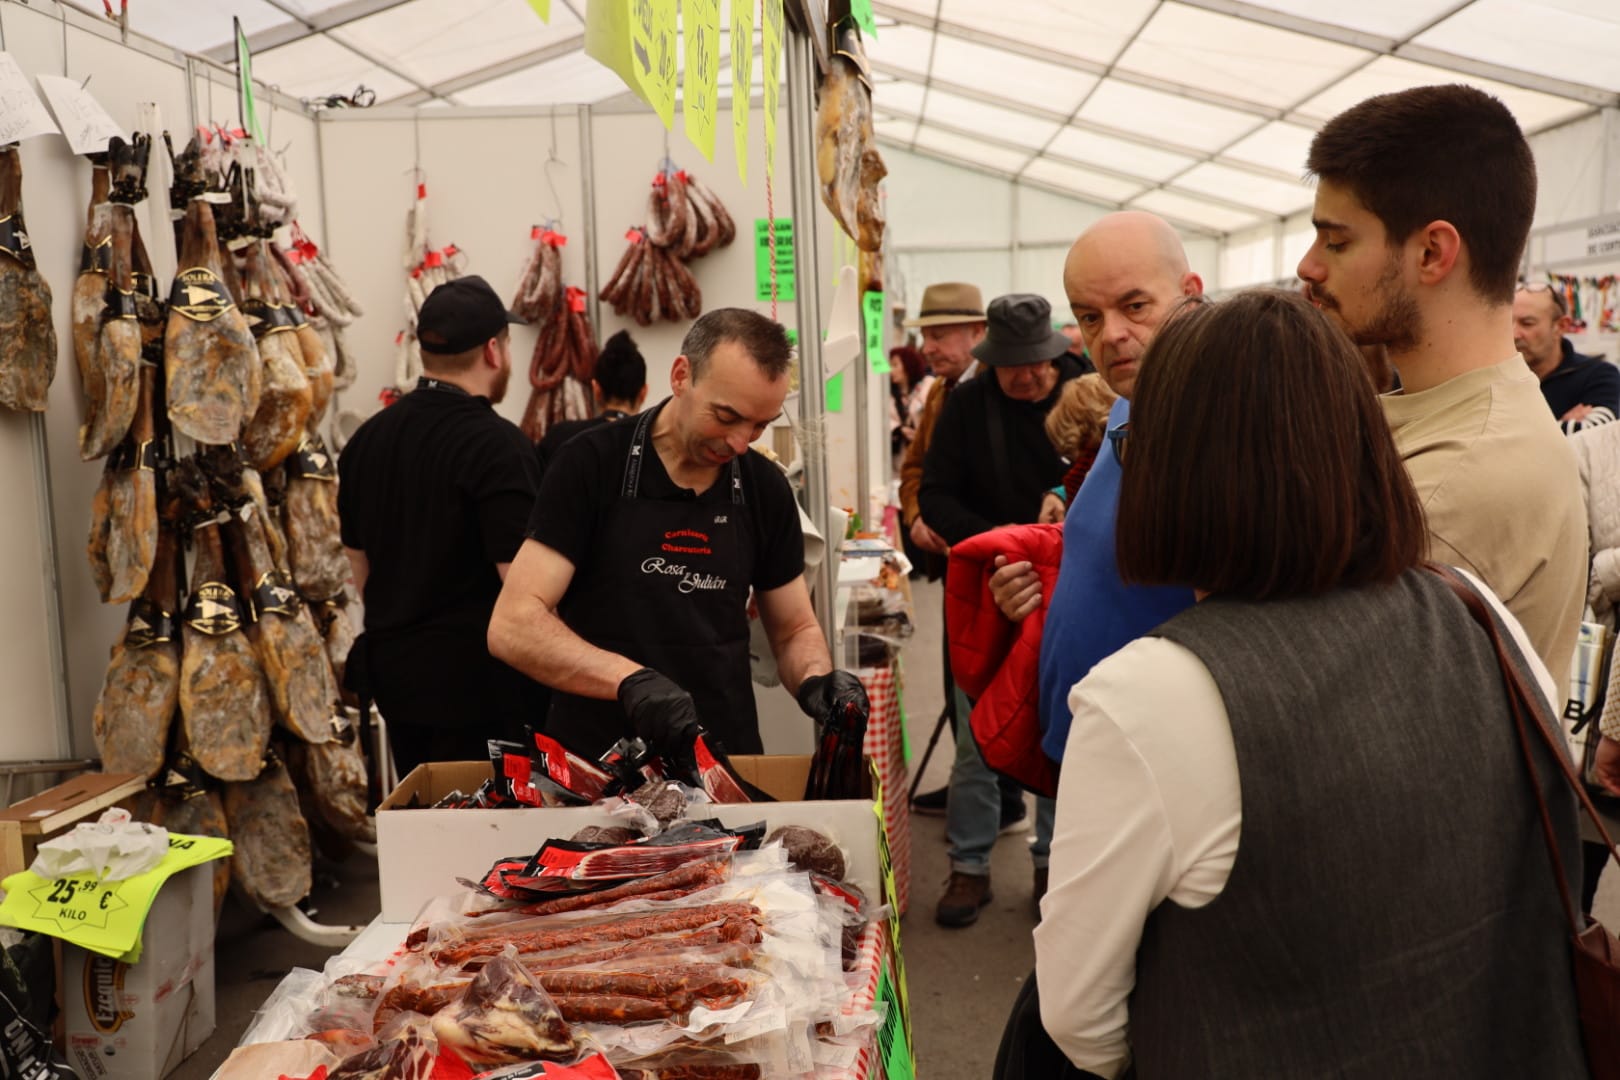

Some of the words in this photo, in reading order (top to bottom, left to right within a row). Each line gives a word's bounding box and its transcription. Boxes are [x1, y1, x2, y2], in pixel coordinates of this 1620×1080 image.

[641, 557, 687, 575] Rosa
[99, 891, 112, 910] €
[59, 907, 87, 921] KILO
[94, 957, 115, 1021] Ezequie
